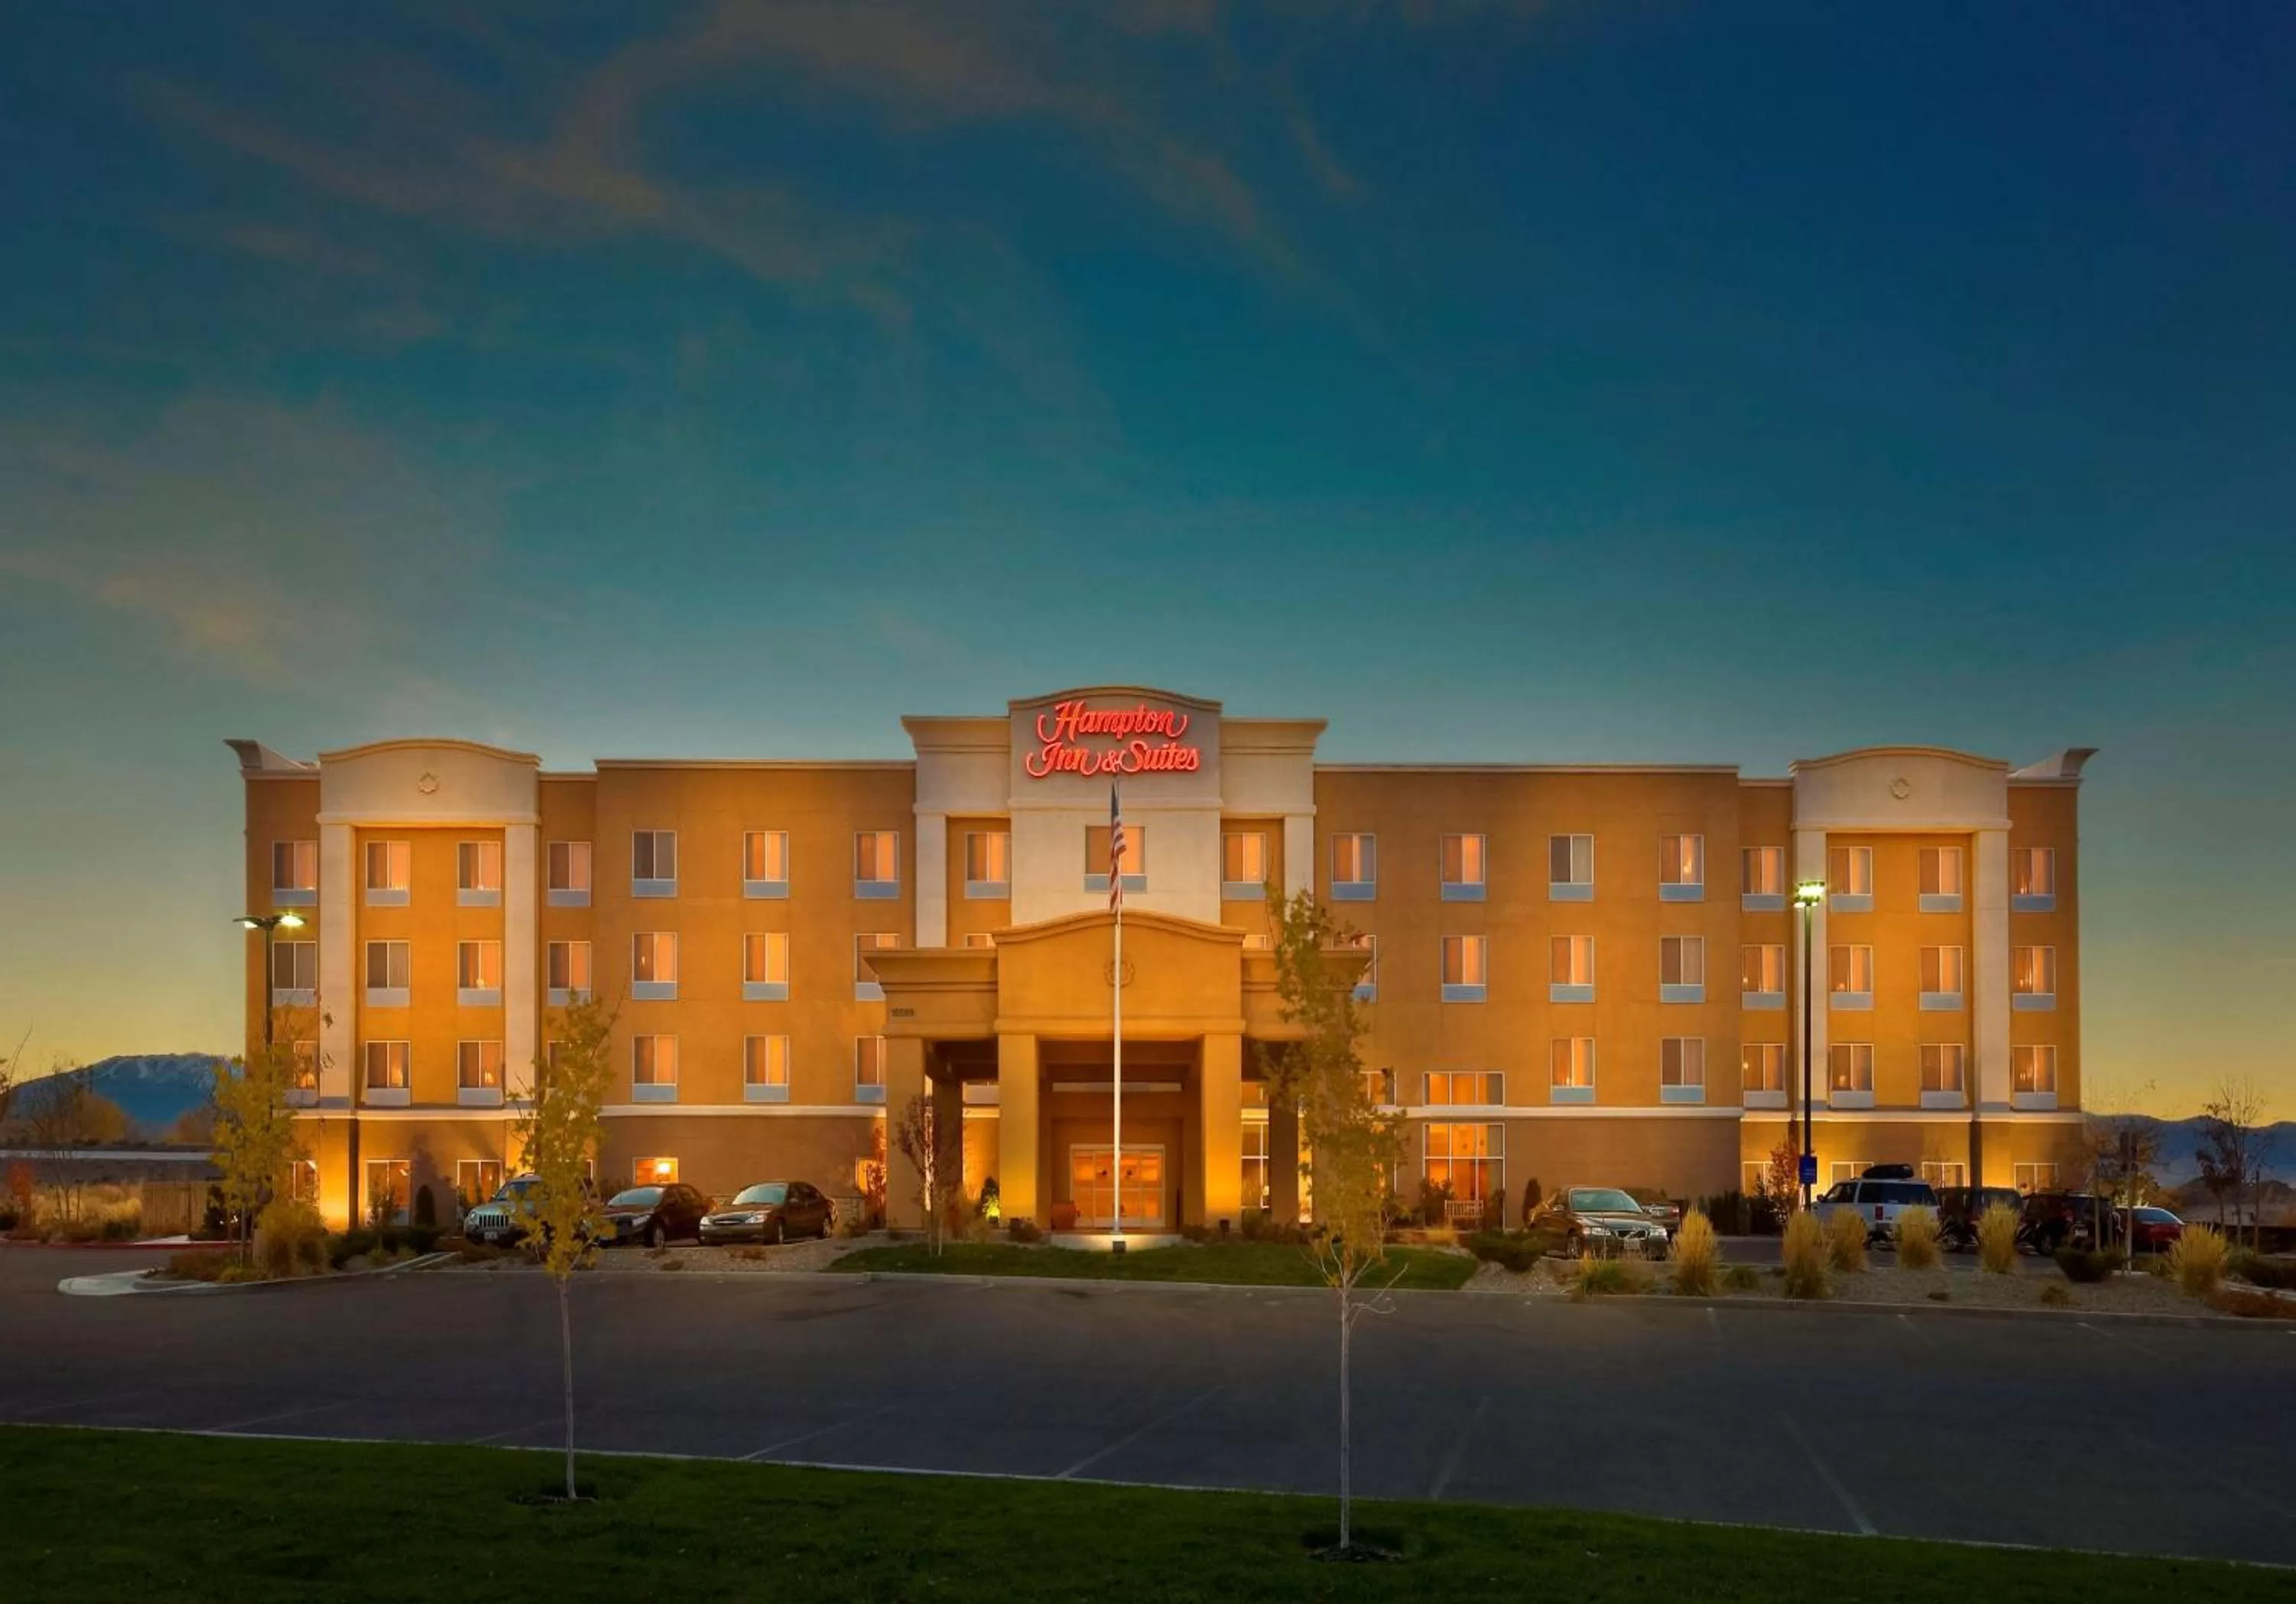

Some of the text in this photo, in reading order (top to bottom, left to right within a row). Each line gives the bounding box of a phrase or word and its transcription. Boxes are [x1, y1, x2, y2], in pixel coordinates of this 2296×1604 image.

[1038, 700, 1187, 742] Hampton
[1026, 741, 1199, 776] Inn & Suites
